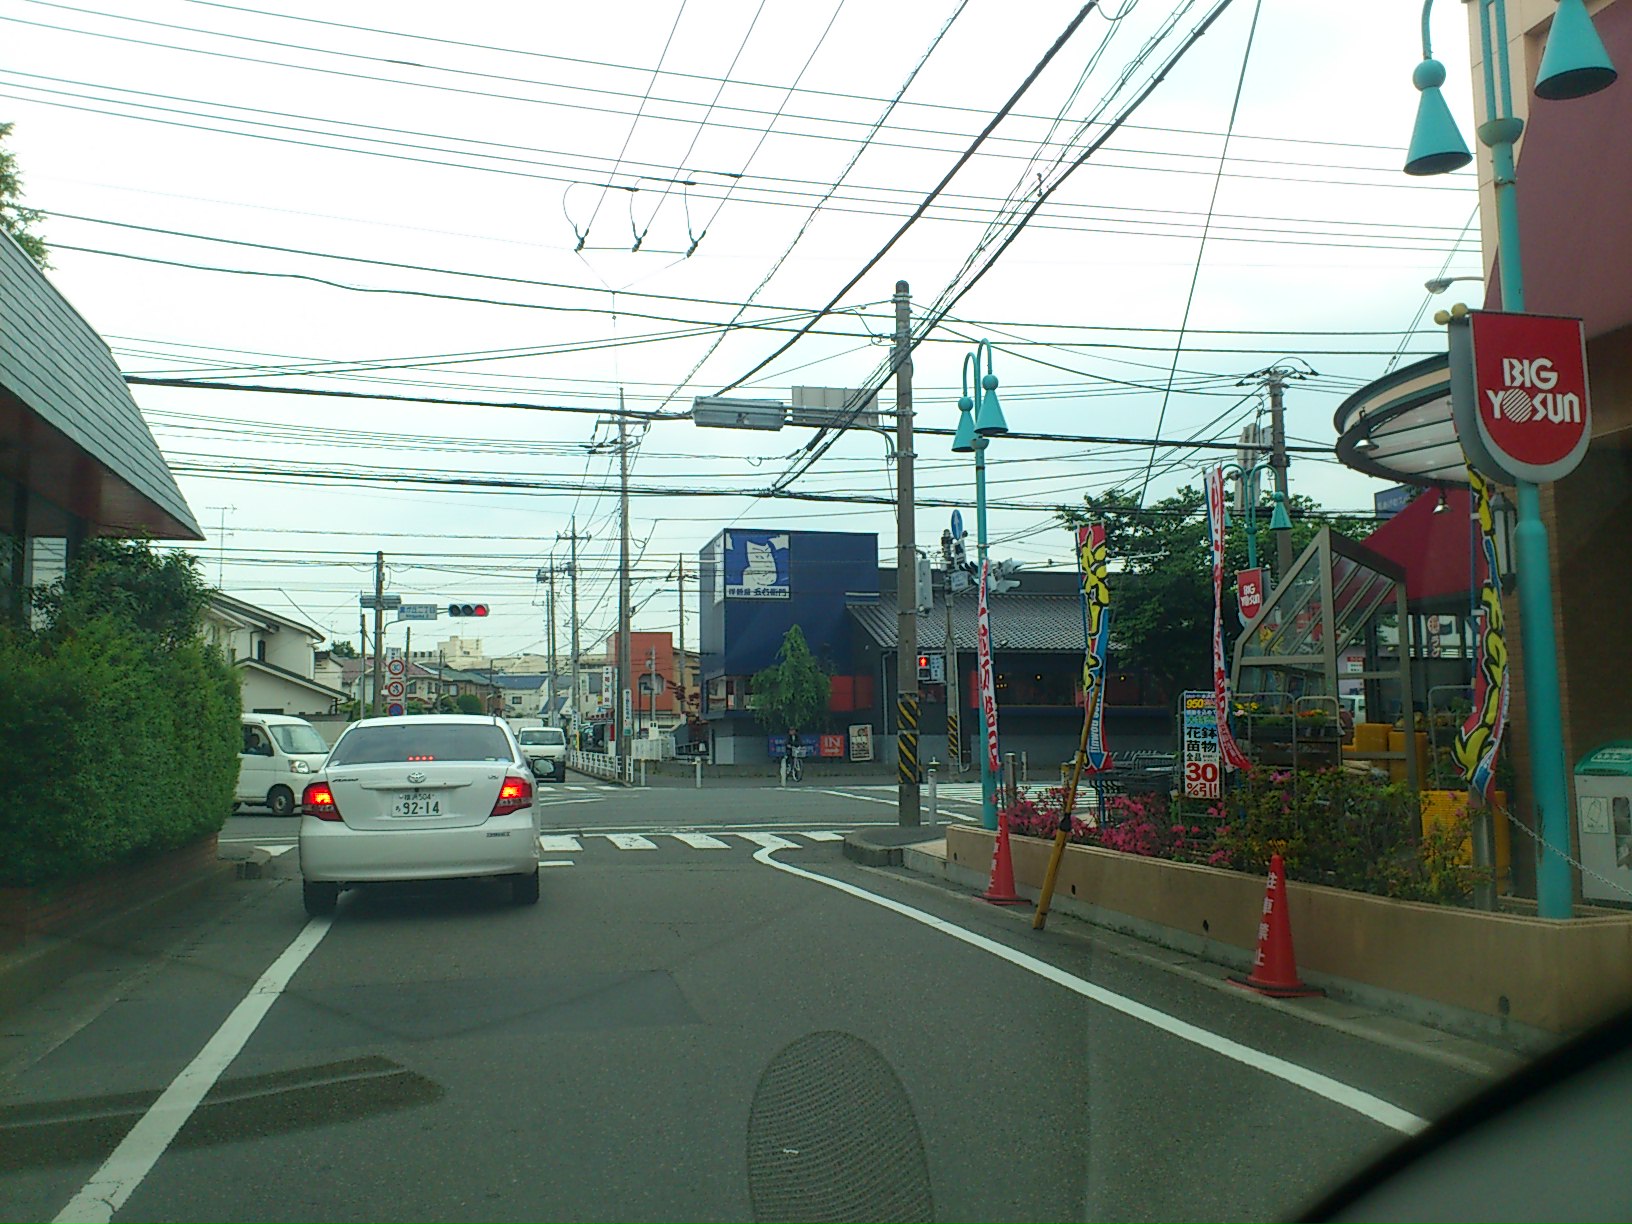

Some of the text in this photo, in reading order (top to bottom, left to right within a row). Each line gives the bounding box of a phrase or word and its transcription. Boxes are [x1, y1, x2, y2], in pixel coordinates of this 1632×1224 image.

[1502, 357, 1558, 390] BIG
[1243, 583, 1256, 596] BIG
[1186, 698, 1204, 709] 950
[1186, 726, 1217, 739] 花鉢
[824, 737, 840, 747] IN
[1186, 740, 1217, 753] 苗物
[1186, 753, 1202, 762] 全品
[1186, 762, 1218, 783] 30
[402, 801, 440, 815] 92-14
